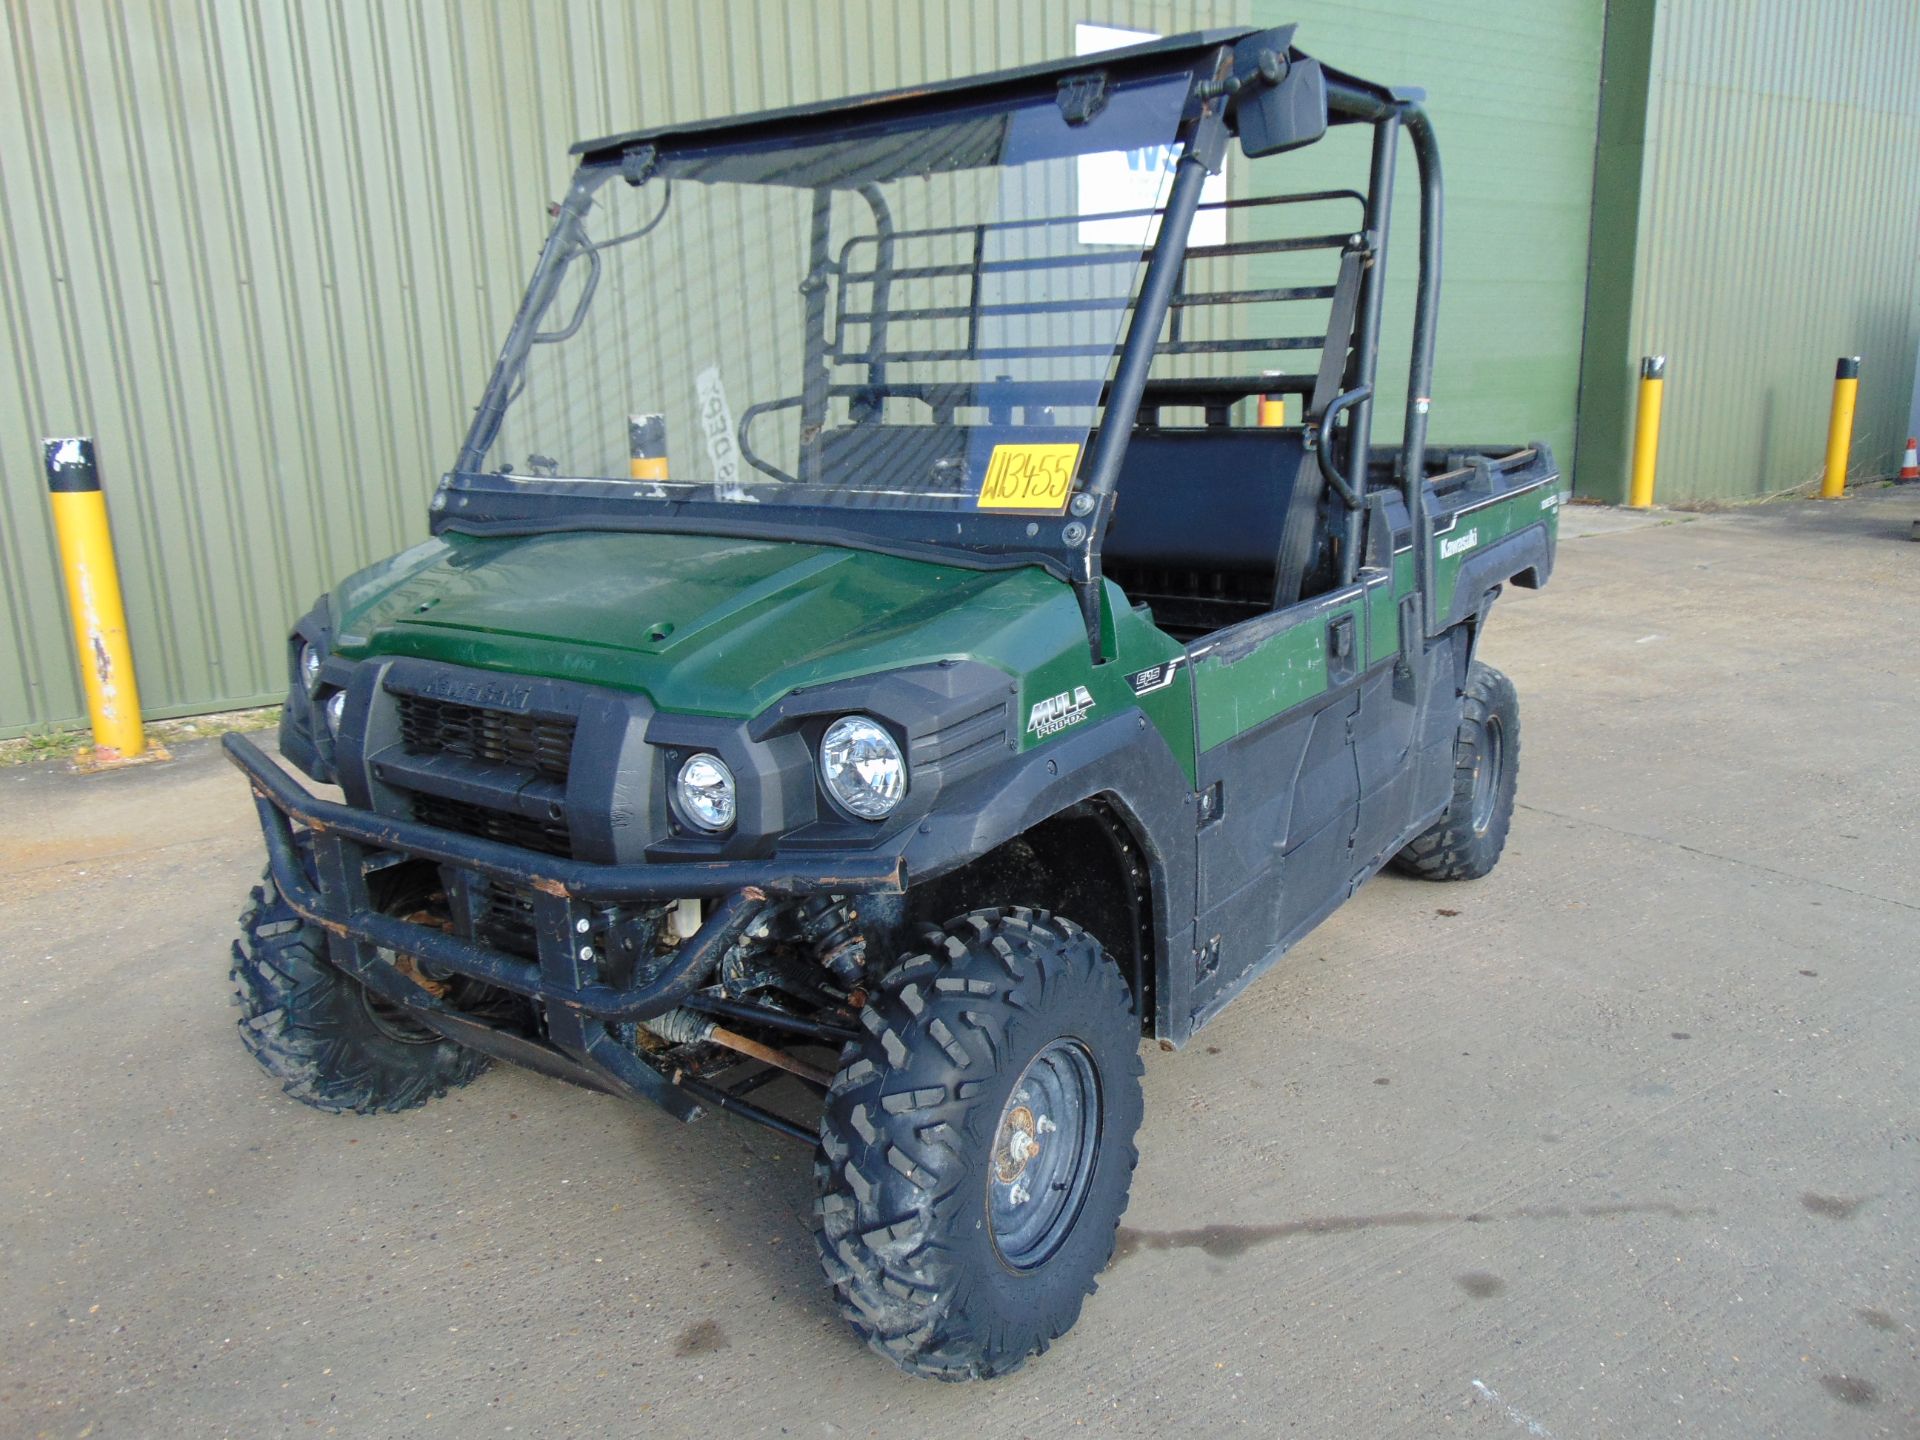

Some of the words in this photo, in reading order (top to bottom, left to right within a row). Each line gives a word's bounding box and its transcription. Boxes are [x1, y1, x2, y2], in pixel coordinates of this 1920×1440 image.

[1440, 527, 1478, 560] Kawasaki
[1027, 685, 1096, 732] MULE
[1036, 709, 1088, 739] PRO-DX
